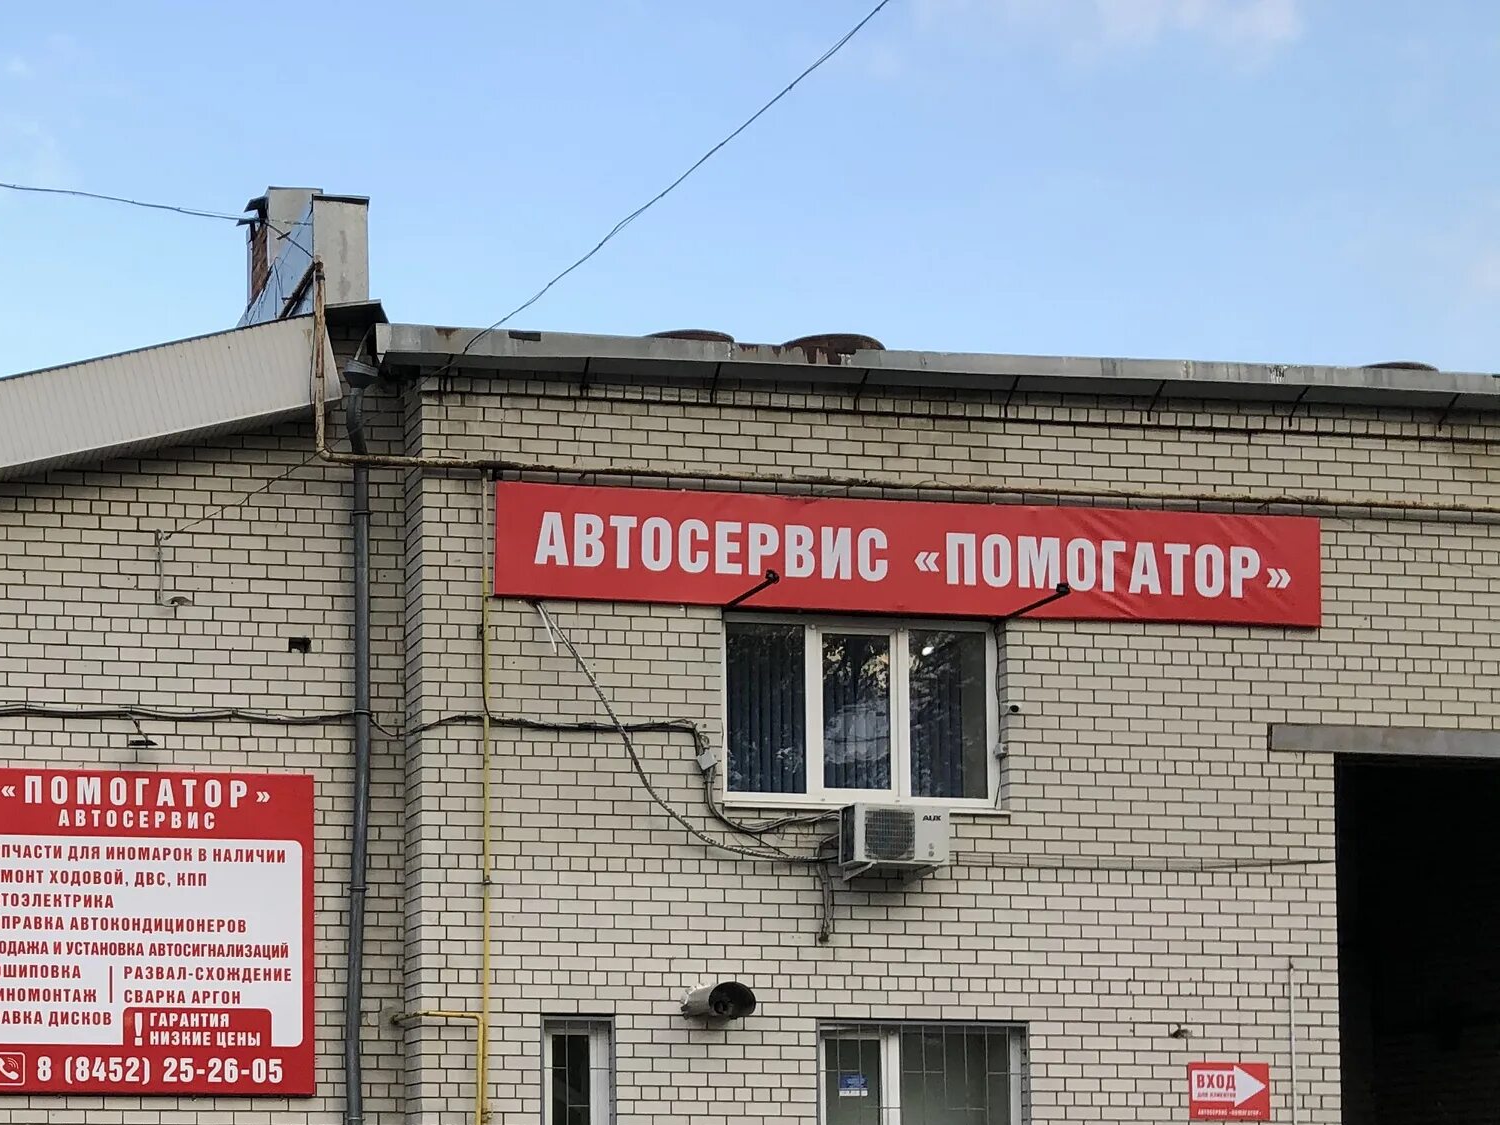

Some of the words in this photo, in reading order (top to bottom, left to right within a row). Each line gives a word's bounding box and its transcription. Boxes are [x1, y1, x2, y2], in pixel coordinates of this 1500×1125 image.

[533, 512, 889, 582] АВТОСЕРВИС
[913, 532, 1292, 600] «ПОМОГАТОР»
[1, 775, 270, 808] «ПОМОГАТОР»
[58, 809, 216, 830] АВТОСЕРВИС
[67, 846, 101, 861] ДЛЯ
[105, 848, 193, 861] ИНОМАРОК
[198, 849, 207, 862] В
[212, 849, 286, 863] НАЛИЧИИ
[49, 869, 129, 887] ХОДОВОЙ,
[134, 872, 171, 888] ДВС,
[177, 873, 207, 887] КПП
[70, 917, 247, 934] АВТОКОНДИЦИОНЕРОВ
[53, 942, 62, 955] И
[66, 942, 144, 956] УСТАНОВКА
[148, 941, 289, 960] АВТОСИГНАЛИЗАЦИЙ
[123, 966, 292, 983] РАЗВАЛ-СХОЖДЕНИЕ
[123, 990, 186, 1003] СВАРКА
[192, 991, 241, 1004] АРГОН
[48, 1012, 112, 1027] ДИСКОВ
[149, 1013, 229, 1027] ГАРАНТИЯ
[149, 1032, 211, 1046] НИЗКИЕ
[216, 1033, 261, 1048] ЦЕНЫ
[37, 1057, 52, 1081] 8
[64, 1057, 150, 1084] (8452)
[163, 1058, 283, 1083] 25-26-05
[1197, 1074, 1236, 1091] ВХОД
